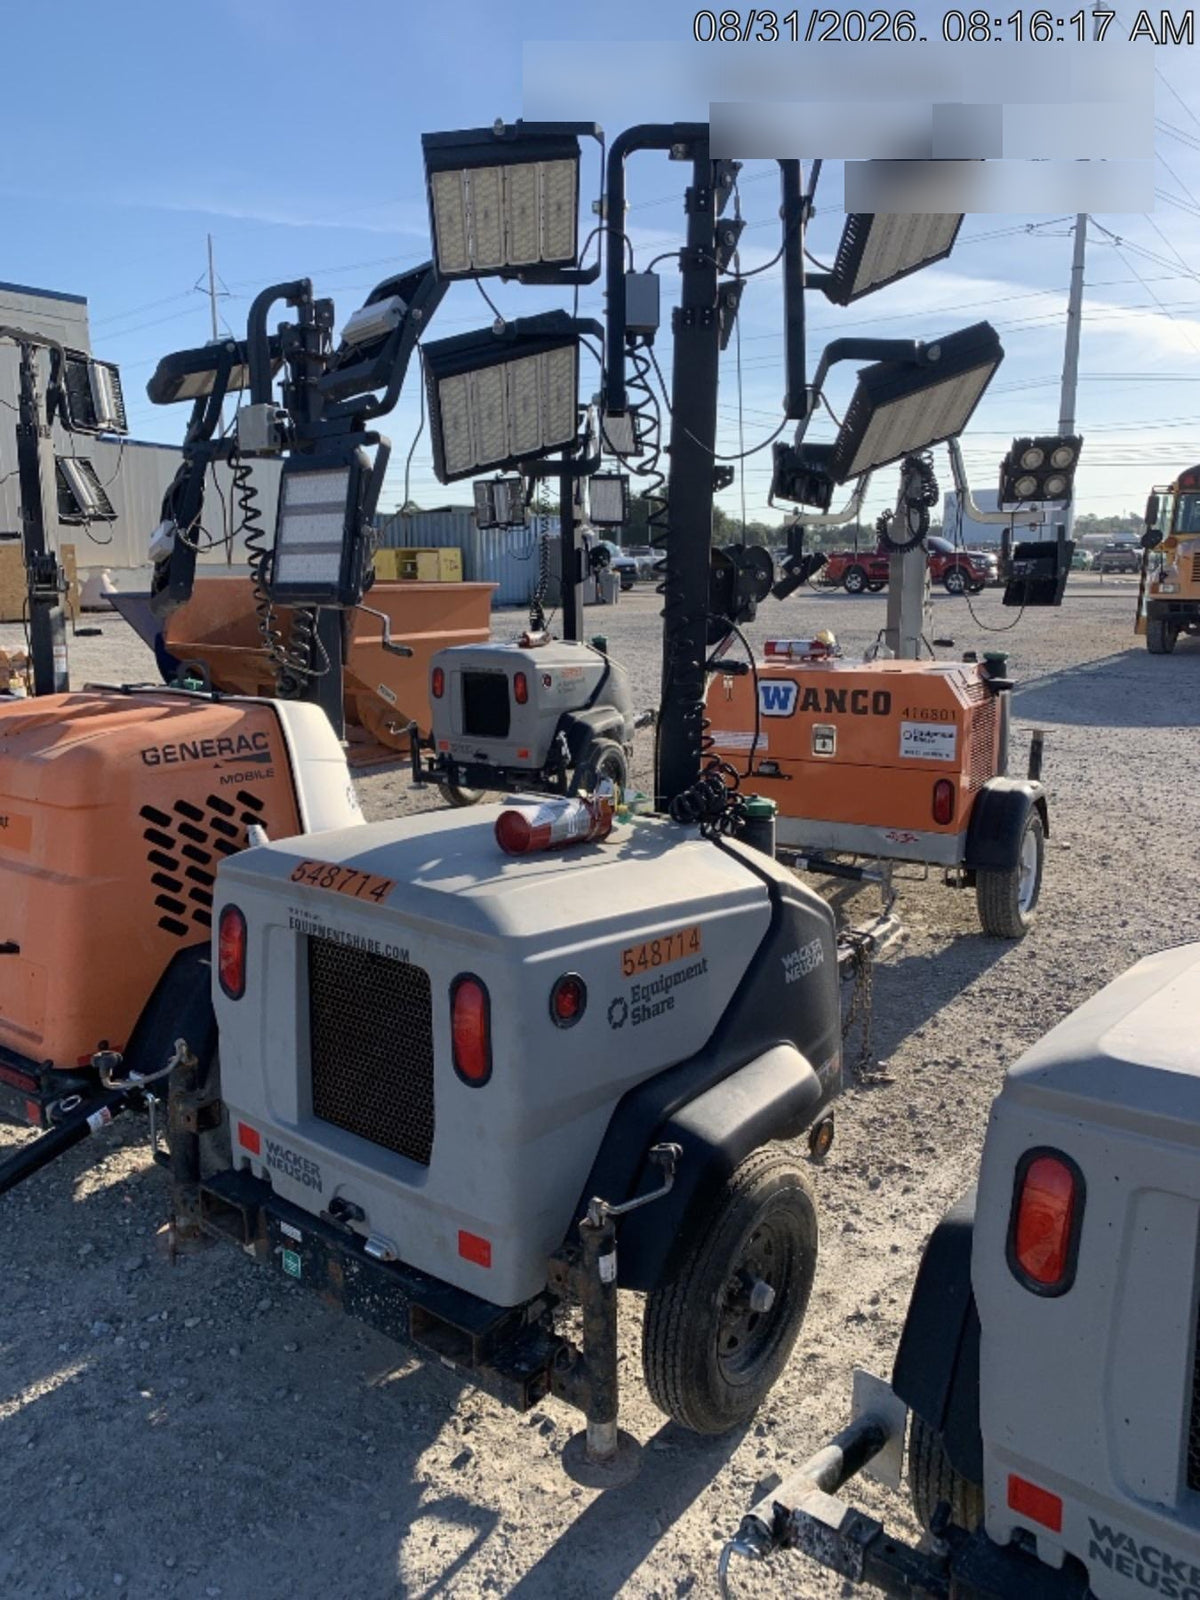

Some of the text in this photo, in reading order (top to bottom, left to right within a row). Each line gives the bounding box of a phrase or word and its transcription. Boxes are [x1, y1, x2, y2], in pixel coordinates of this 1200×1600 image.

[759, 683, 892, 717] WANCO
[901, 707, 957, 722] 416801
[140, 731, 271, 767] GENERAC
[219, 767, 276, 786] MOBILE
[290, 861, 392, 903] 548714
[288, 916, 410, 962] EQUIPMENTSHARE.COM
[623, 927, 701, 977] 548714
[781, 937, 823, 968] WACKER
[630, 957, 709, 1005] Equipment
[785, 952, 825, 984] NEUSON
[630, 996, 675, 1027] Share
[265, 1138, 322, 1178] WACKER
[266, 1154, 323, 1194] NEUSON
[1087, 1514, 1200, 1588] WACKE
